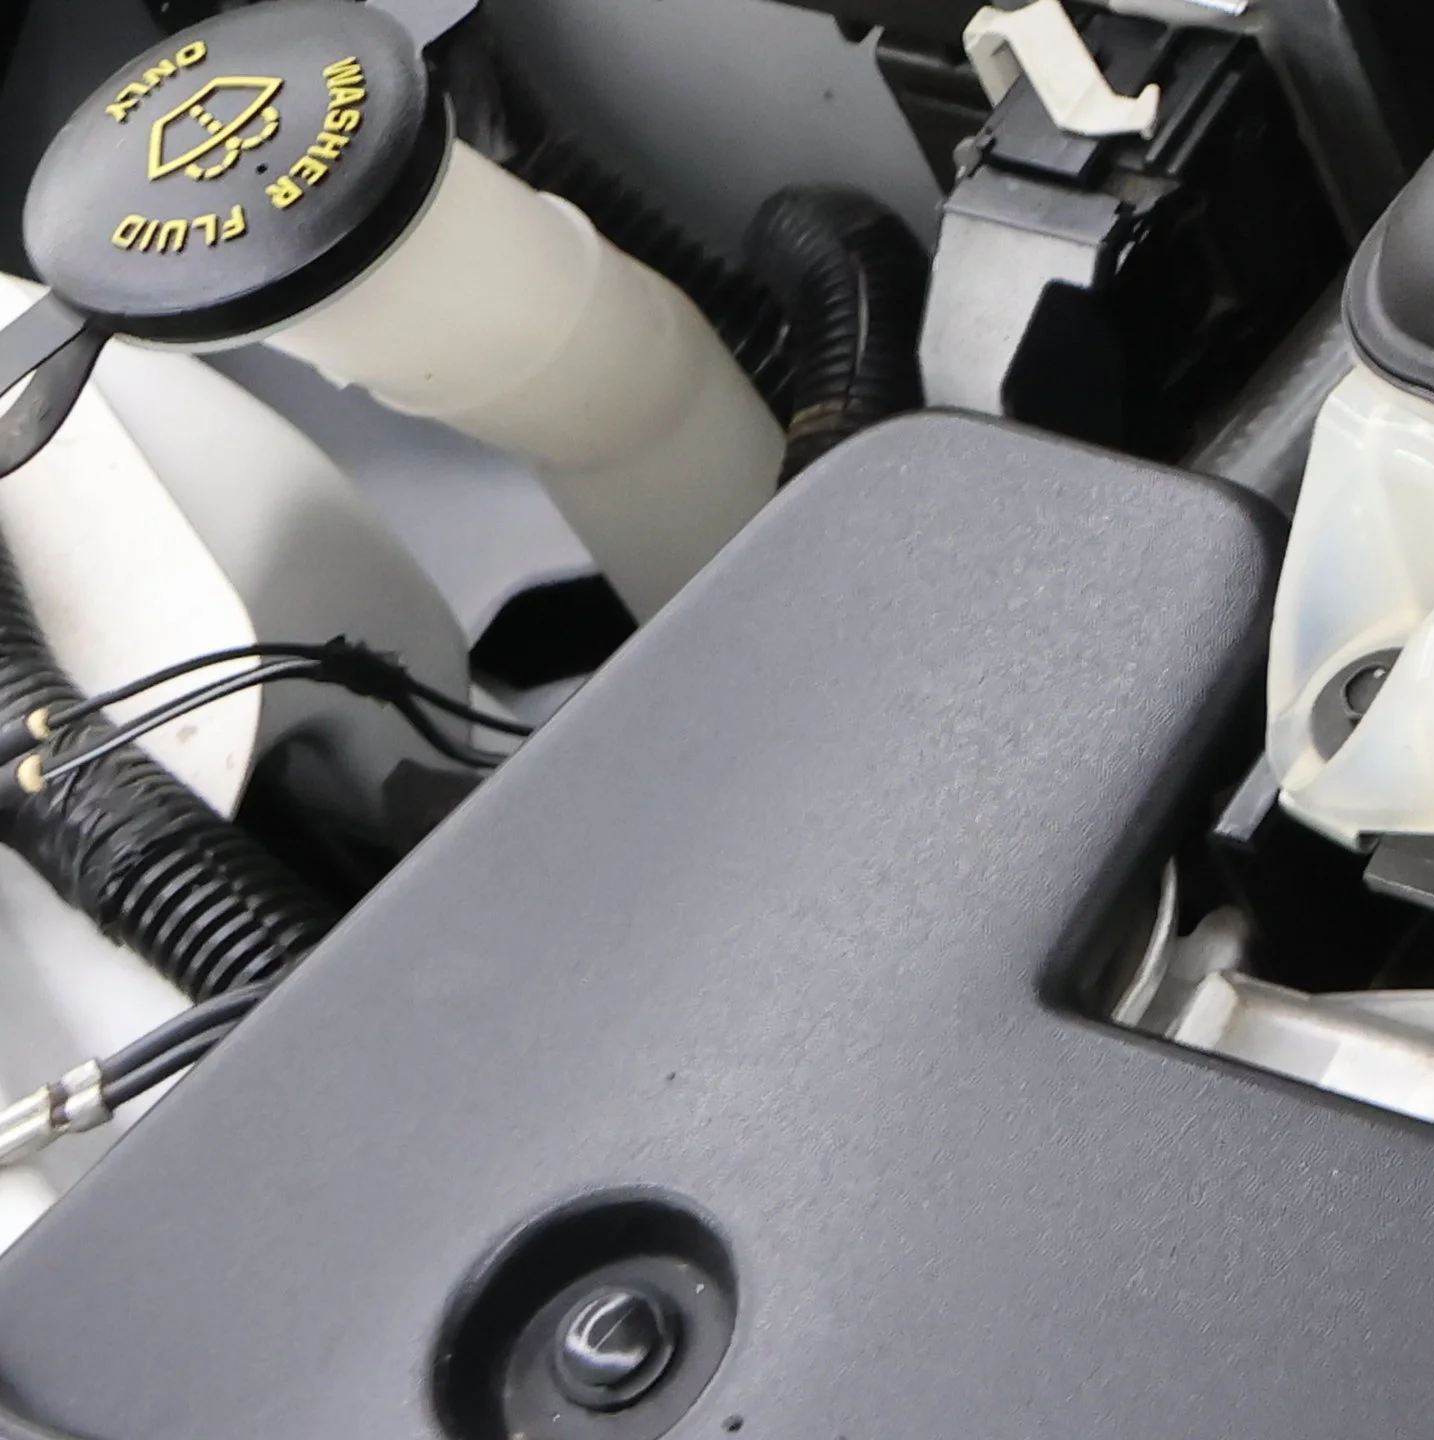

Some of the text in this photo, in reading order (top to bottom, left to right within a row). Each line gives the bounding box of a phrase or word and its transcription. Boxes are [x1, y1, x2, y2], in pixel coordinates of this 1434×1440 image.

[104, 40, 368, 253] WASHER FLUID ONLY
